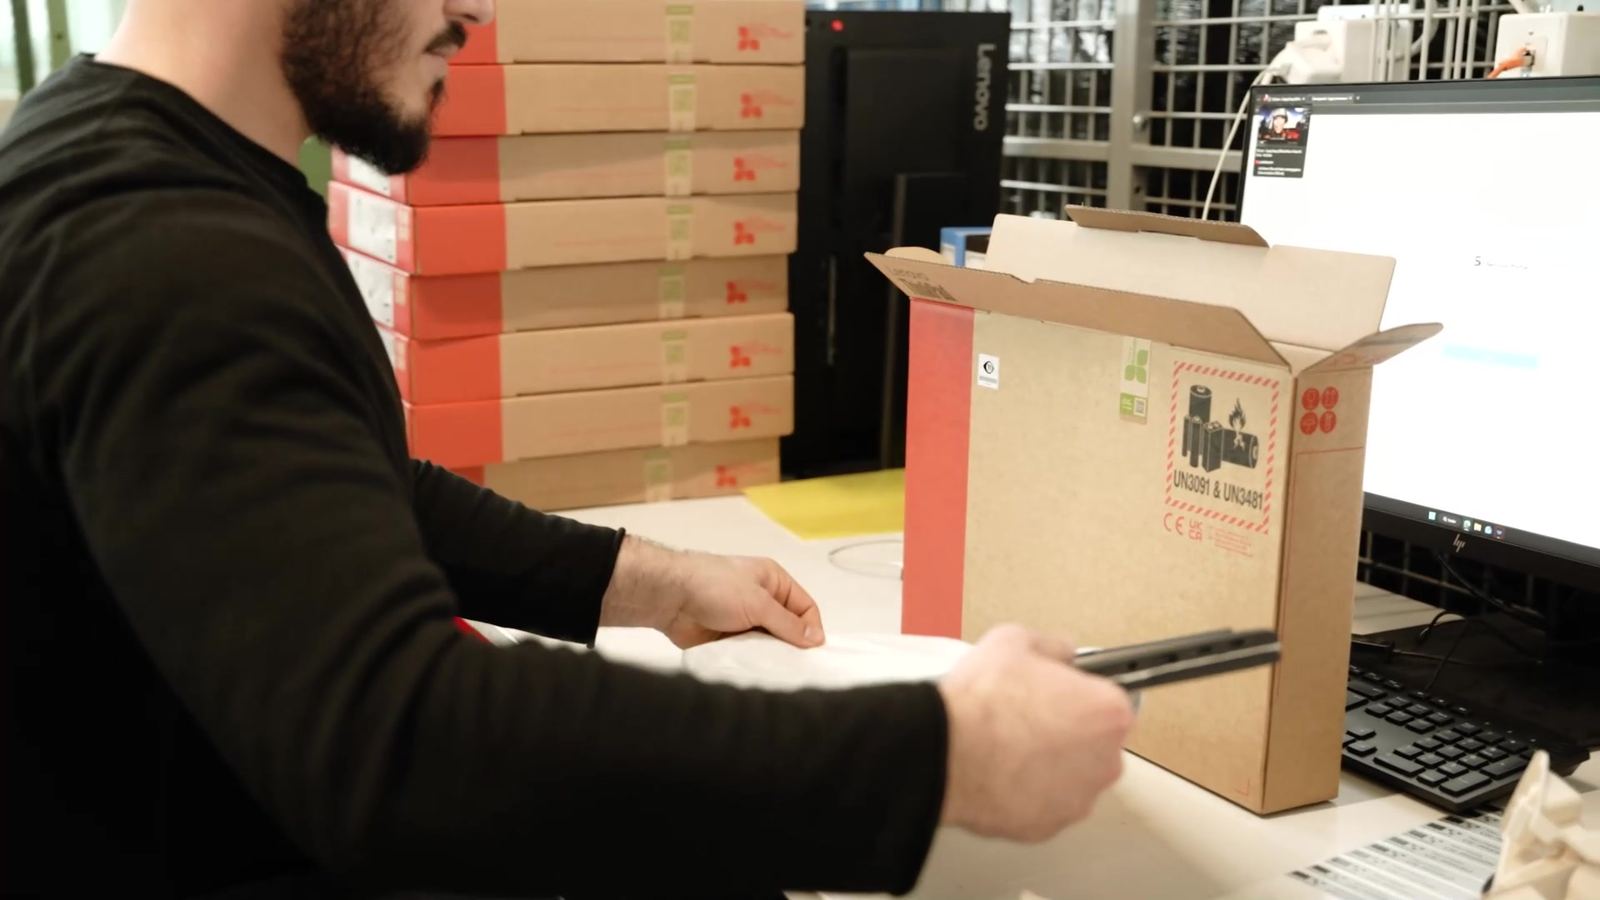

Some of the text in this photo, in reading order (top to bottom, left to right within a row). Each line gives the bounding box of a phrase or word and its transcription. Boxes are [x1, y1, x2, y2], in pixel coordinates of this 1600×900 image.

[974, 43, 997, 130] Lenovo
[1173, 469, 1263, 510] UN3091 & UN3481
[1452, 533, 1466, 553] hp
